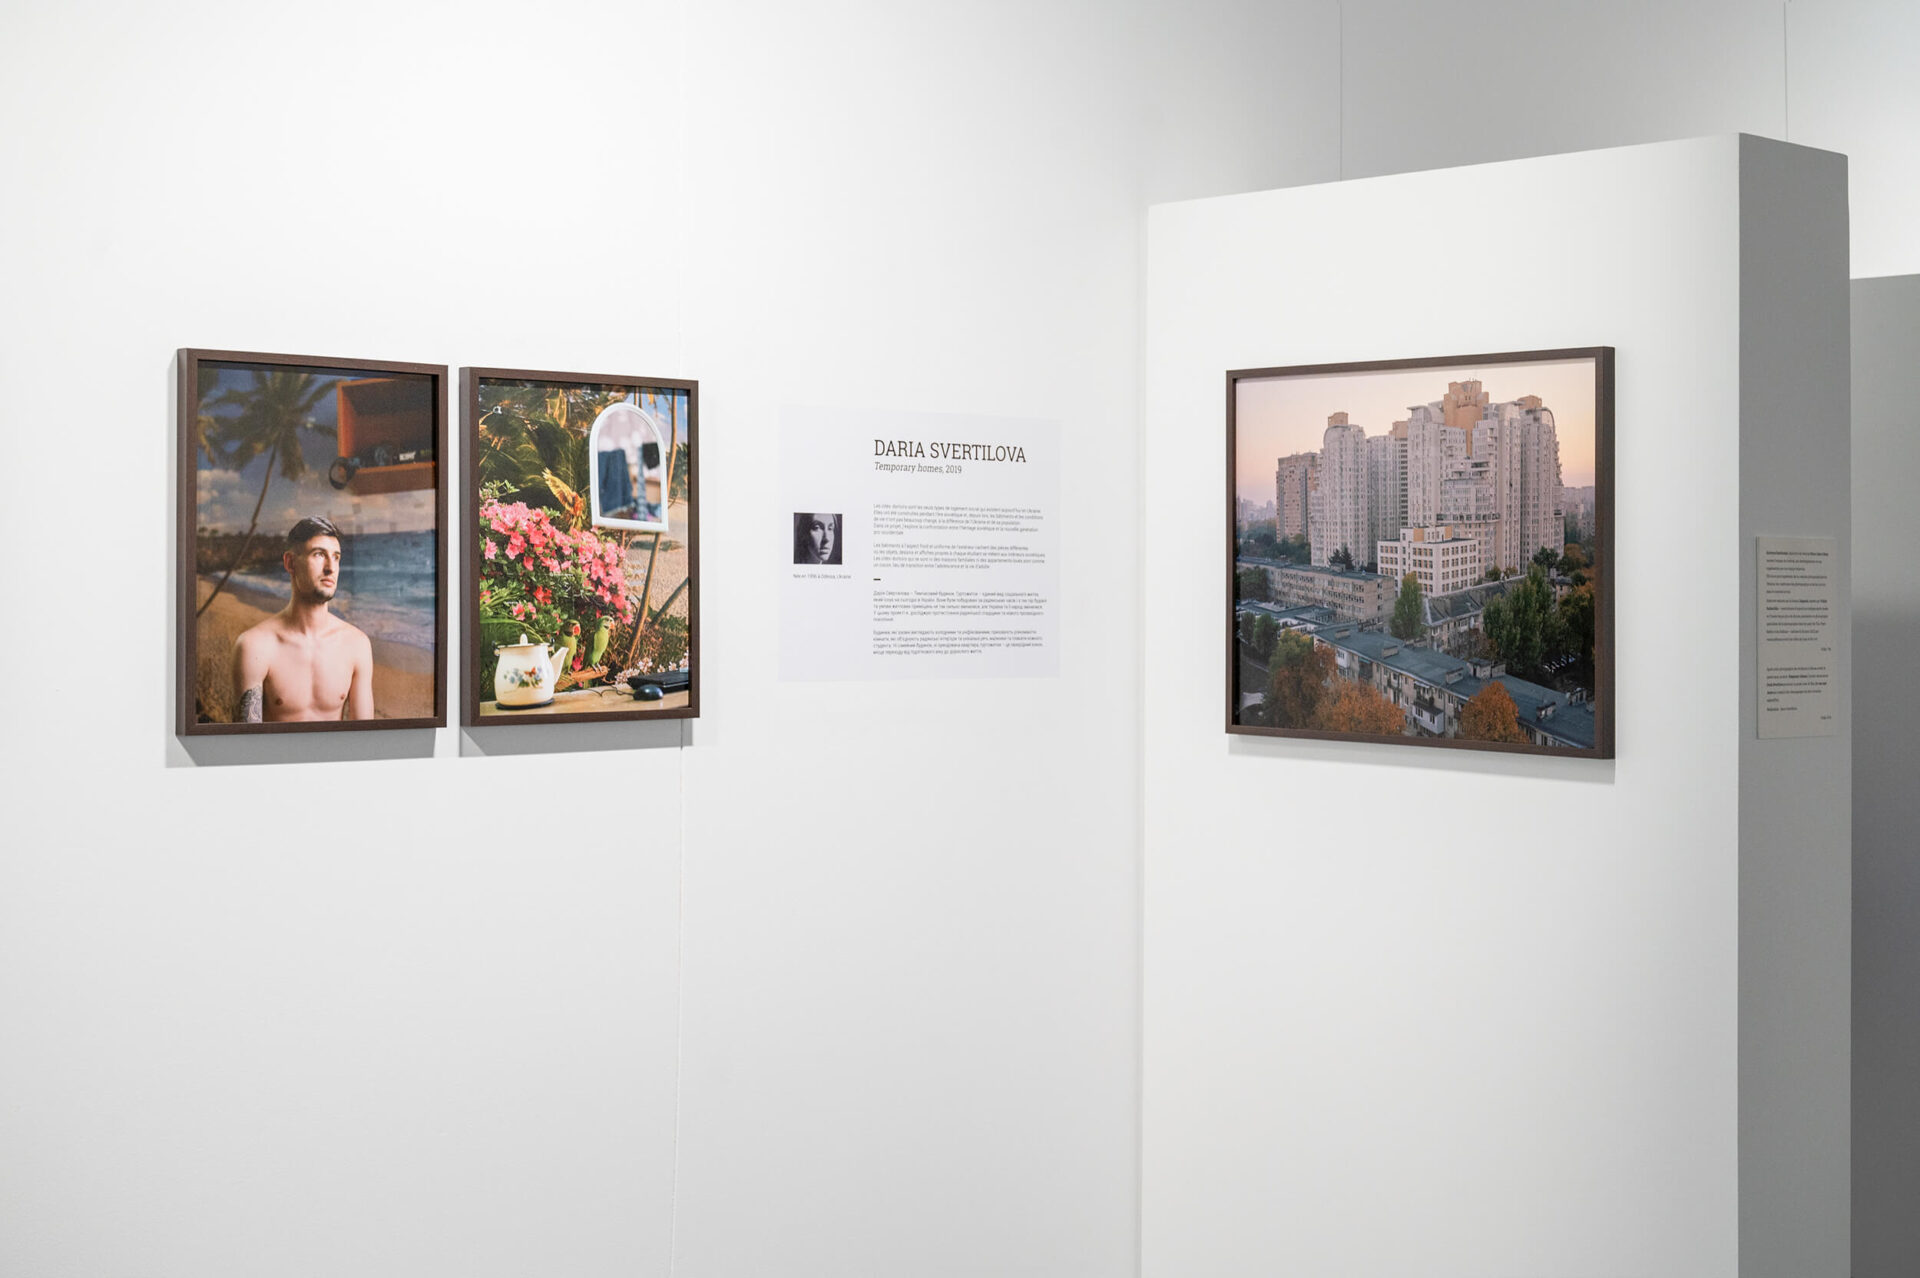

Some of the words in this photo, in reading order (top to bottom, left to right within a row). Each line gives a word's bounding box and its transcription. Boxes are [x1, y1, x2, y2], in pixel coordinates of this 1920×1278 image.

[873, 439, 925, 458] DARIA
[930, 442, 1027, 463] SVERTILOVA
[874, 461, 916, 474] Temporary
[917, 463, 944, 474] homes,
[945, 464, 962, 474] 2019
